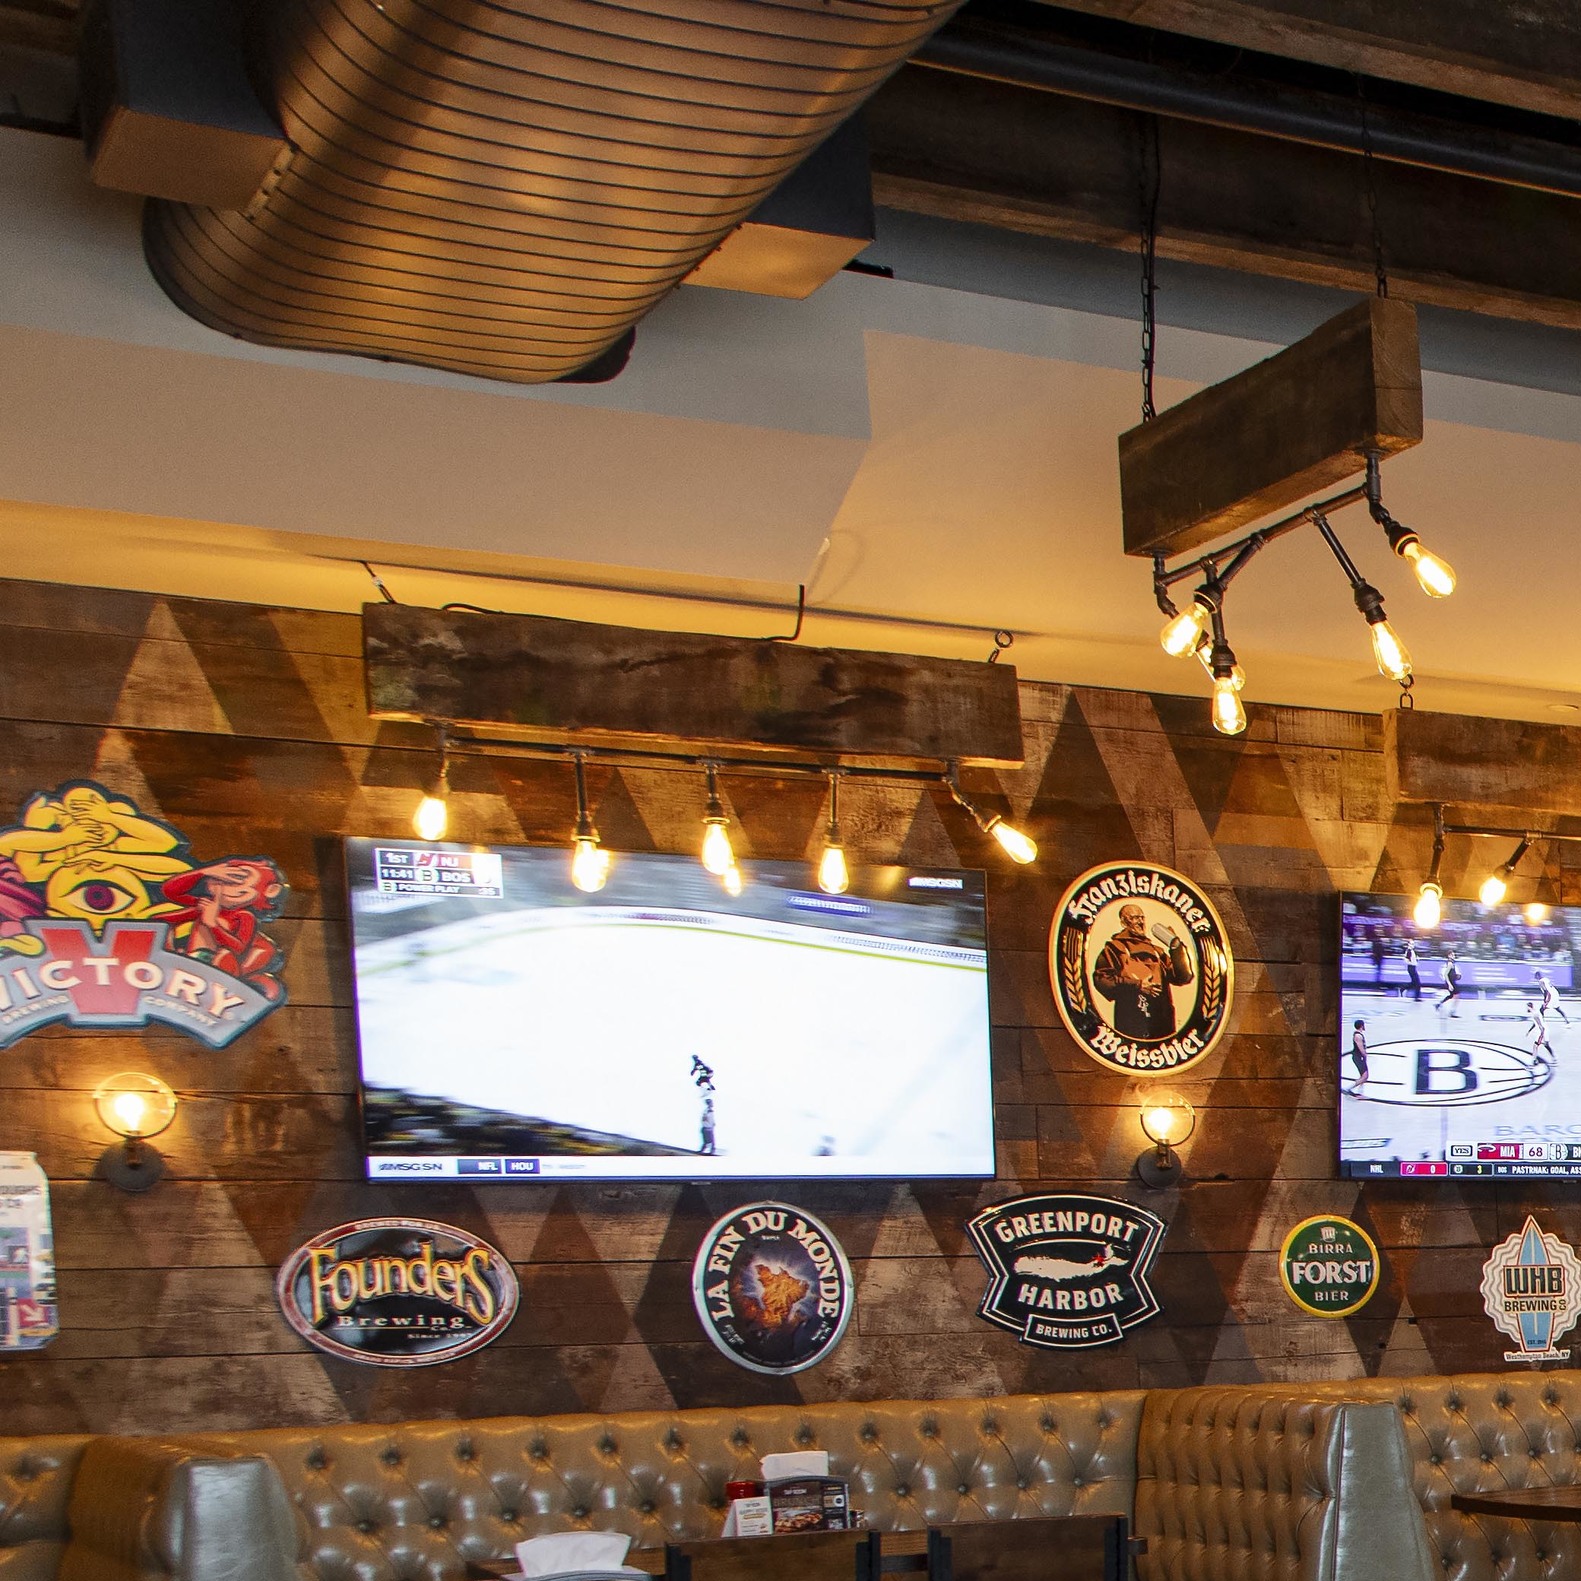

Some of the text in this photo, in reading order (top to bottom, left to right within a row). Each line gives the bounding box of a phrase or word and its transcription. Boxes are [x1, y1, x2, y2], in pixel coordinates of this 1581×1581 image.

[441, 857, 459, 867] NJ
[442, 872, 470, 882] BOS
[398, 884, 434, 892] POWER
[1091, 1025, 1204, 1068] Weissbier
[1415, 1049, 1478, 1094] B
[1500, 1146, 1515, 1157] MIA
[1528, 1147, 1543, 1157] 68
[478, 1161, 498, 1171] NFL
[511, 1161, 533, 1171] HOU
[1370, 1165, 1383, 1173] NHL
[1512, 1166, 1549, 1174] PASTRNAK:
[1550, 1166, 1569, 1175] GOAL,
[994, 1211, 1140, 1243] GREENPORT
[1309, 1243, 1353, 1254] BIRRA
[707, 1211, 841, 1322] LA FIN DU MONDE
[1292, 1261, 1371, 1285] FORST
[1505, 1267, 1563, 1295] WHB
[1018, 1283, 1124, 1310] HARBOR
[1314, 1291, 1349, 1301] BIER
[1504, 1299, 1567, 1312] BREWING CO
[338, 1314, 466, 1330] Brewing
[1035, 1323, 1113, 1339] BREWING CO.
